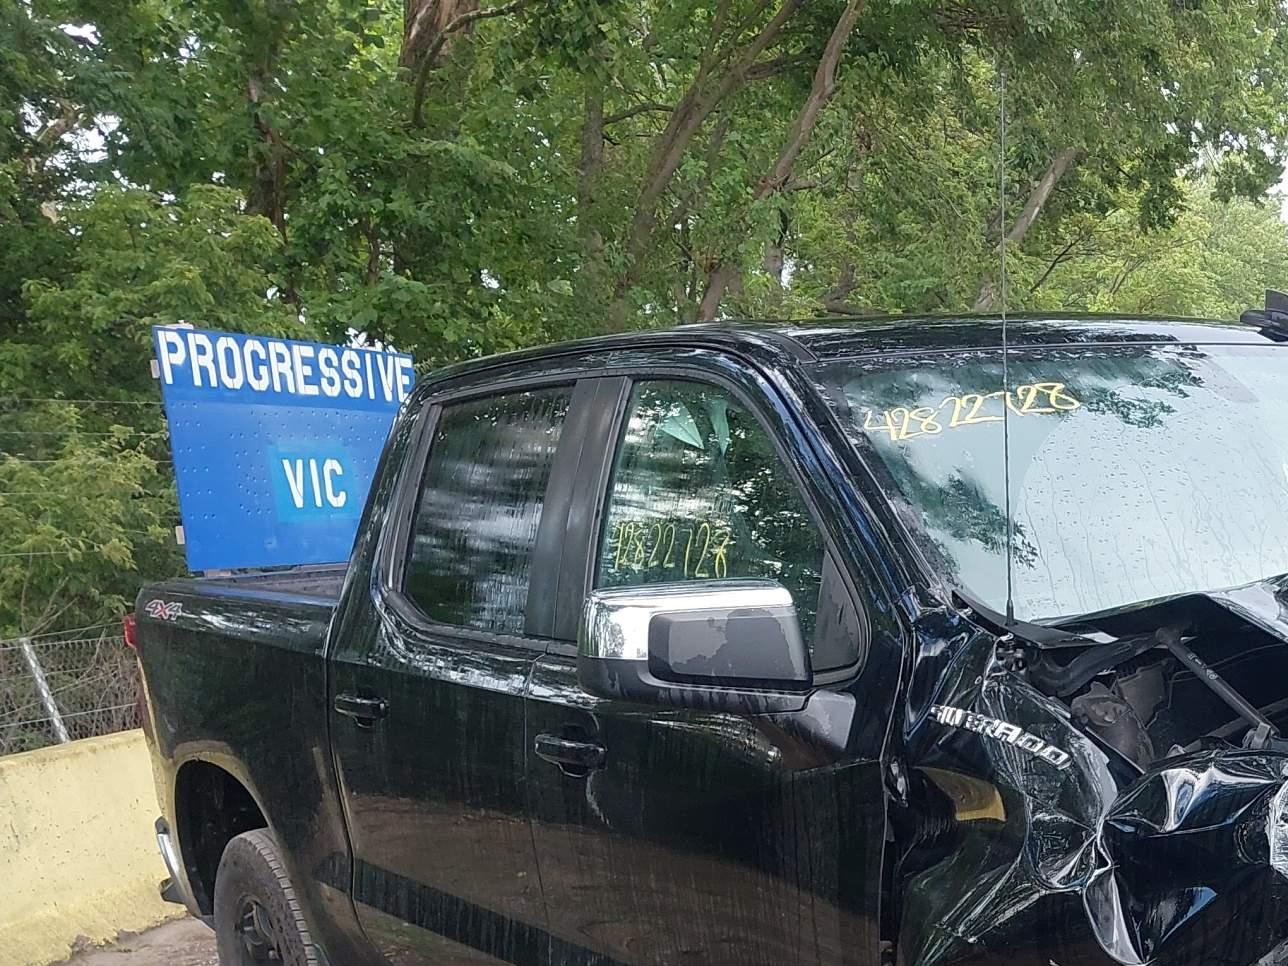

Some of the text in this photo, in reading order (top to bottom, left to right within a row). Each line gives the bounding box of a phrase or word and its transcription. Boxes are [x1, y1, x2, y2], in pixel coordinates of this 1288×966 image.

[158, 330, 413, 403] PROGRESSIVE
[864, 382, 1081, 441] 42822728
[281, 458, 347, 508] VIC
